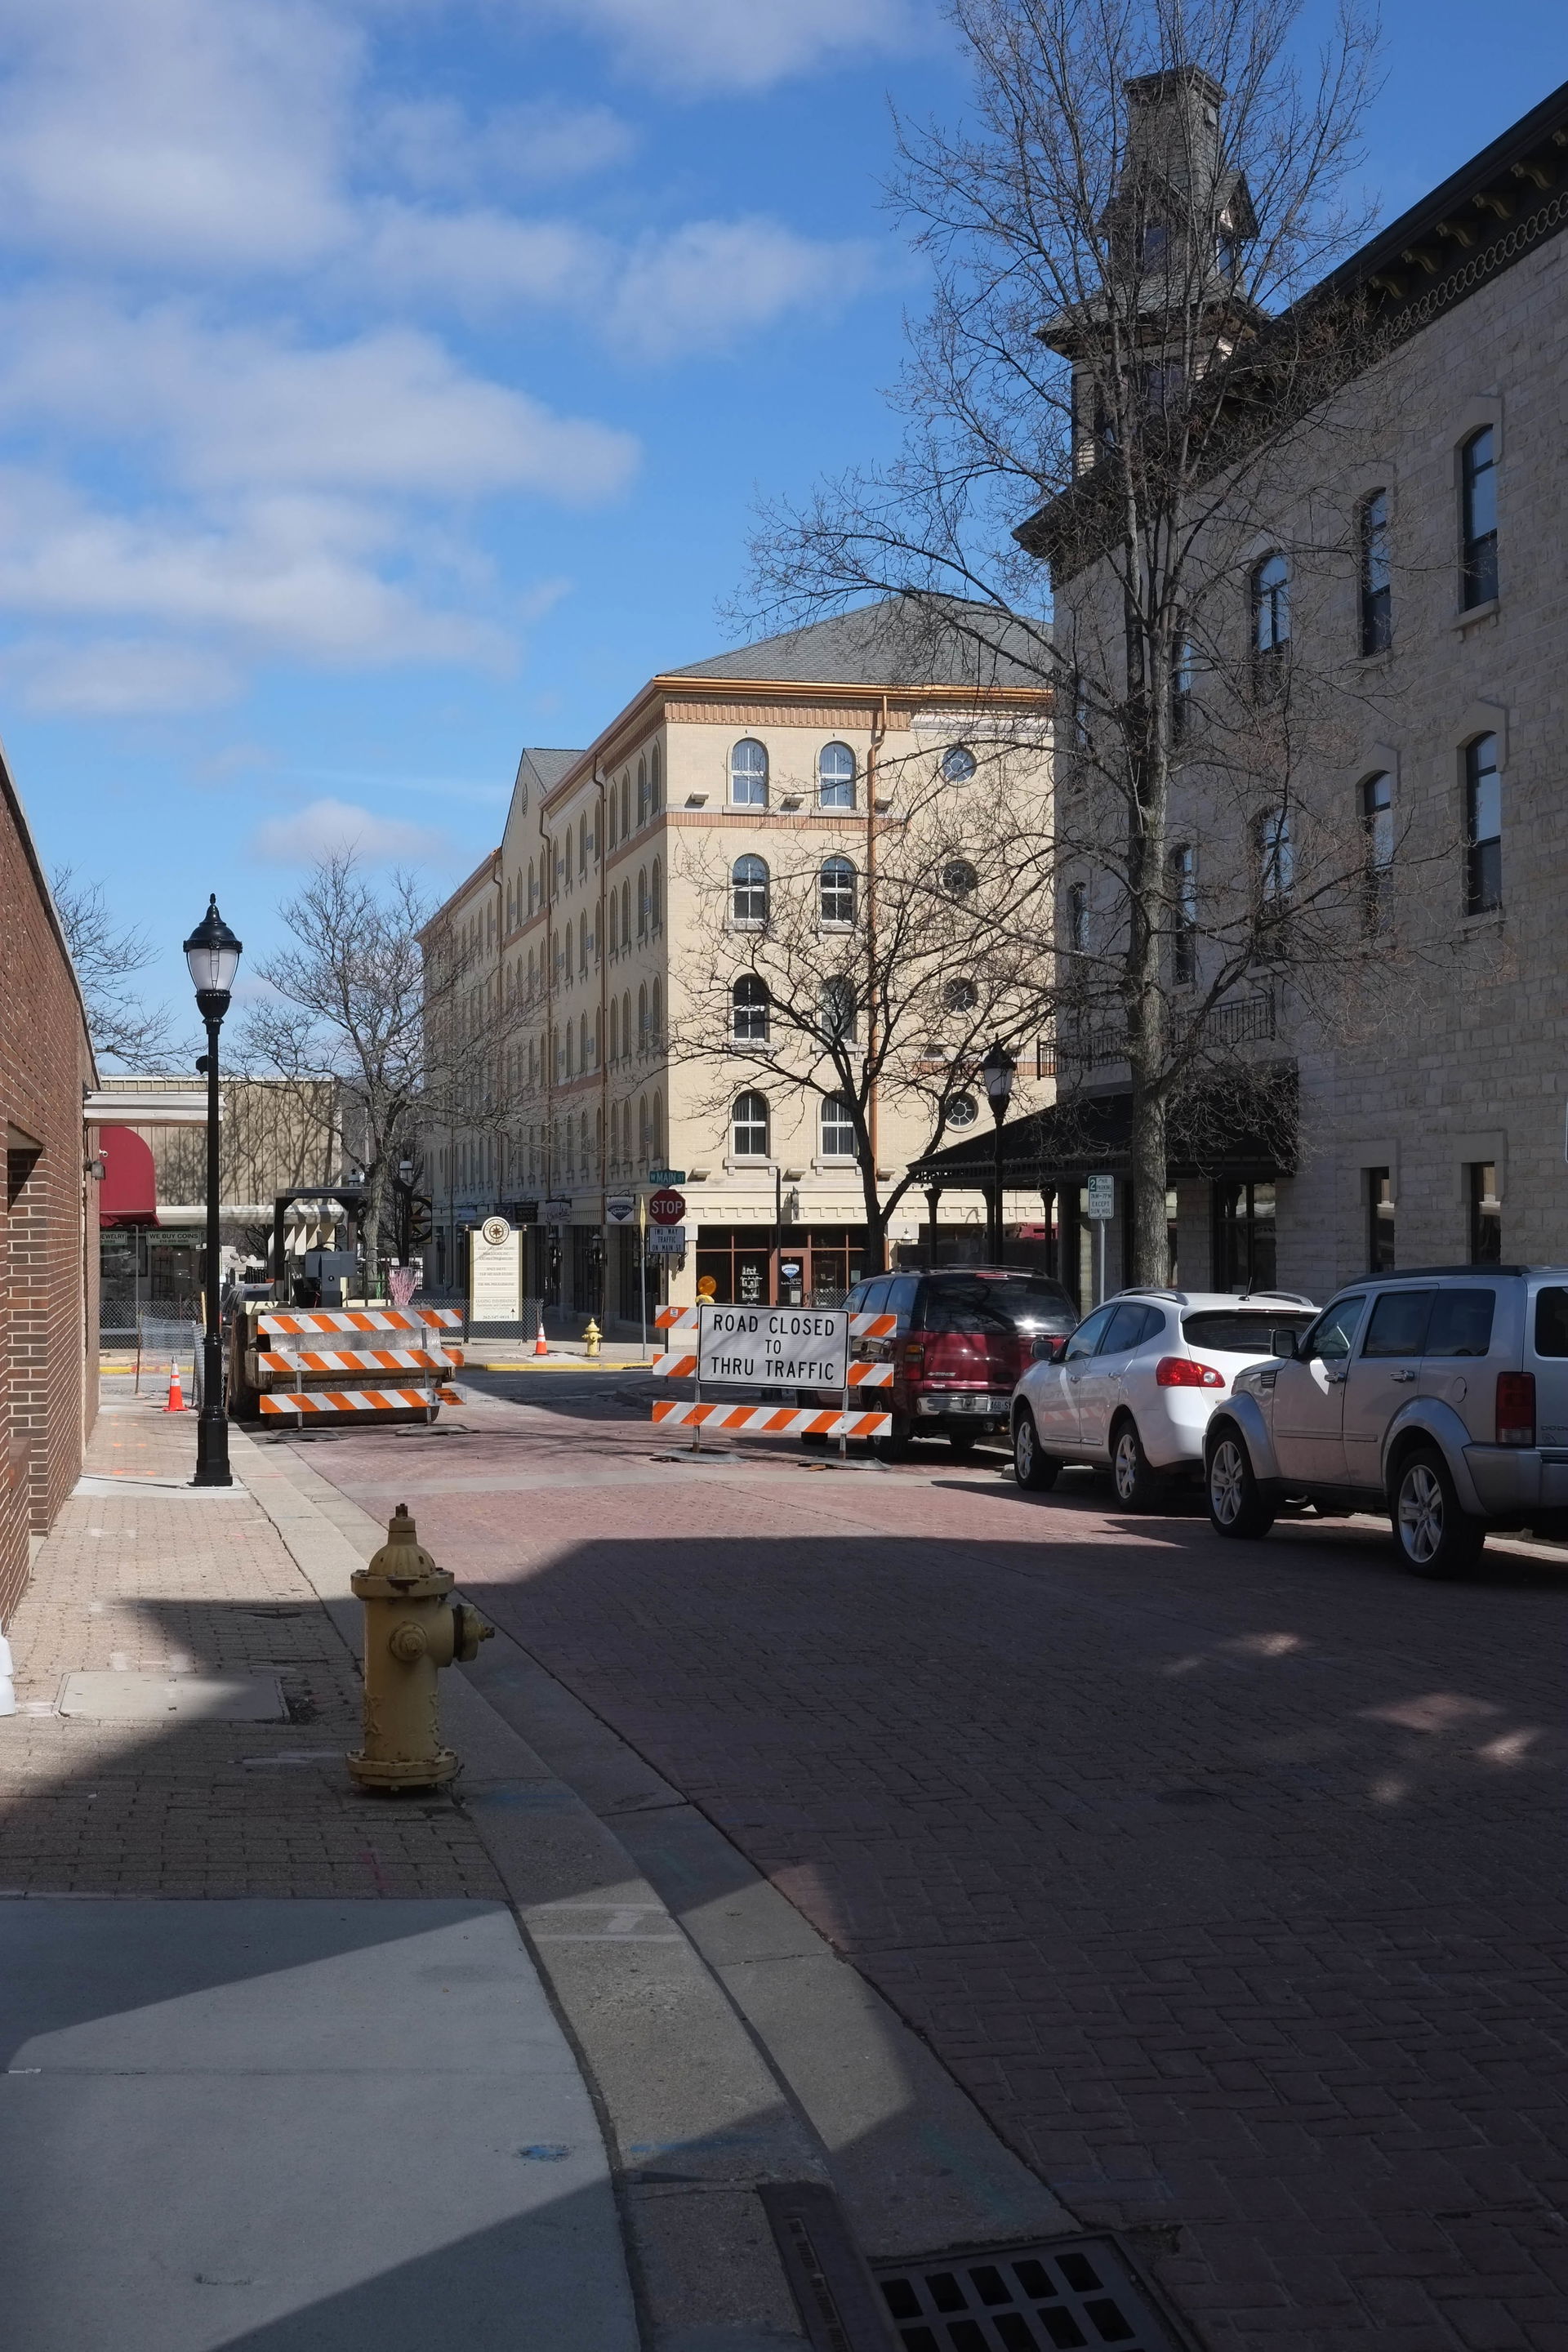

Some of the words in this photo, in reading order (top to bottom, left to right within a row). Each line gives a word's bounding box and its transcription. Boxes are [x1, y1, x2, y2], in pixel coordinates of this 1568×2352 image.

[657, 1172, 676, 1183] MAIN
[1090, 1179, 1096, 1190] 2
[652, 1200, 683, 1214] STOP
[713, 1314, 758, 1333] ROAD
[769, 1316, 835, 1336] CLOSED
[765, 1339, 782, 1354] TO
[711, 1356, 754, 1376] THRU
[765, 1360, 834, 1380] TRAFFIC
